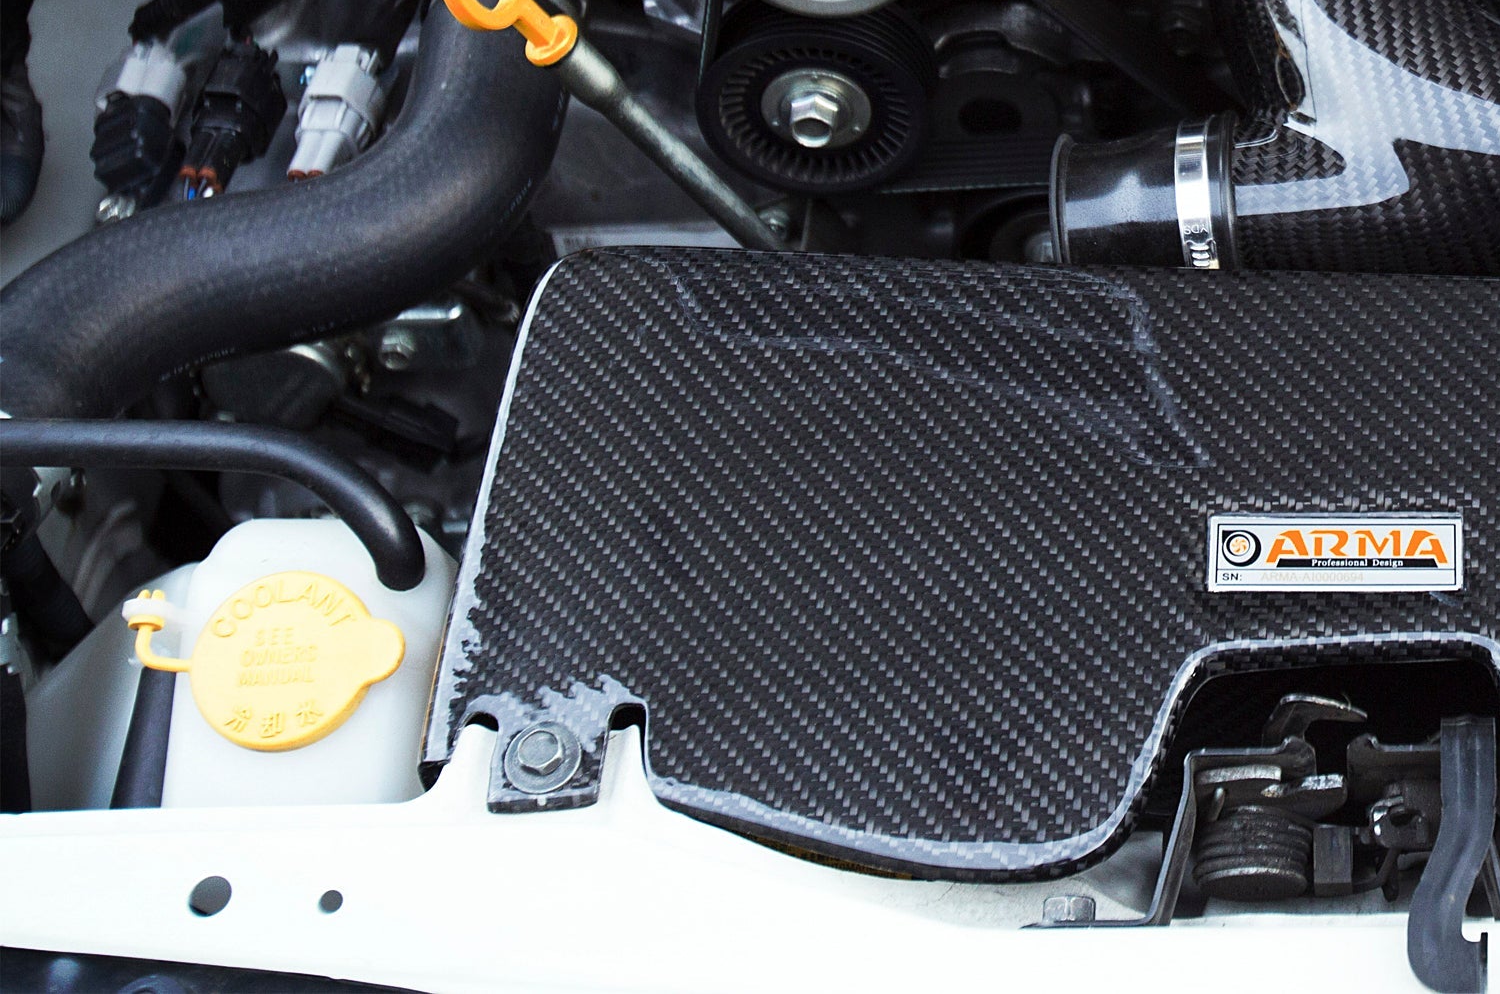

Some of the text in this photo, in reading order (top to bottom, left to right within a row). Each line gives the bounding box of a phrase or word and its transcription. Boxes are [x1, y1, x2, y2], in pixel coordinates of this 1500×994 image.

[1265, 529, 1449, 564] ARMA
[1311, 558, 1404, 569] Professional Design
[1222, 573, 1243, 582] SN:
[211, 582, 357, 639] COOLANT
[254, 627, 296, 646] SEE
[240, 645, 319, 668] OWNERS
[236, 666, 316, 687] MANUAL
